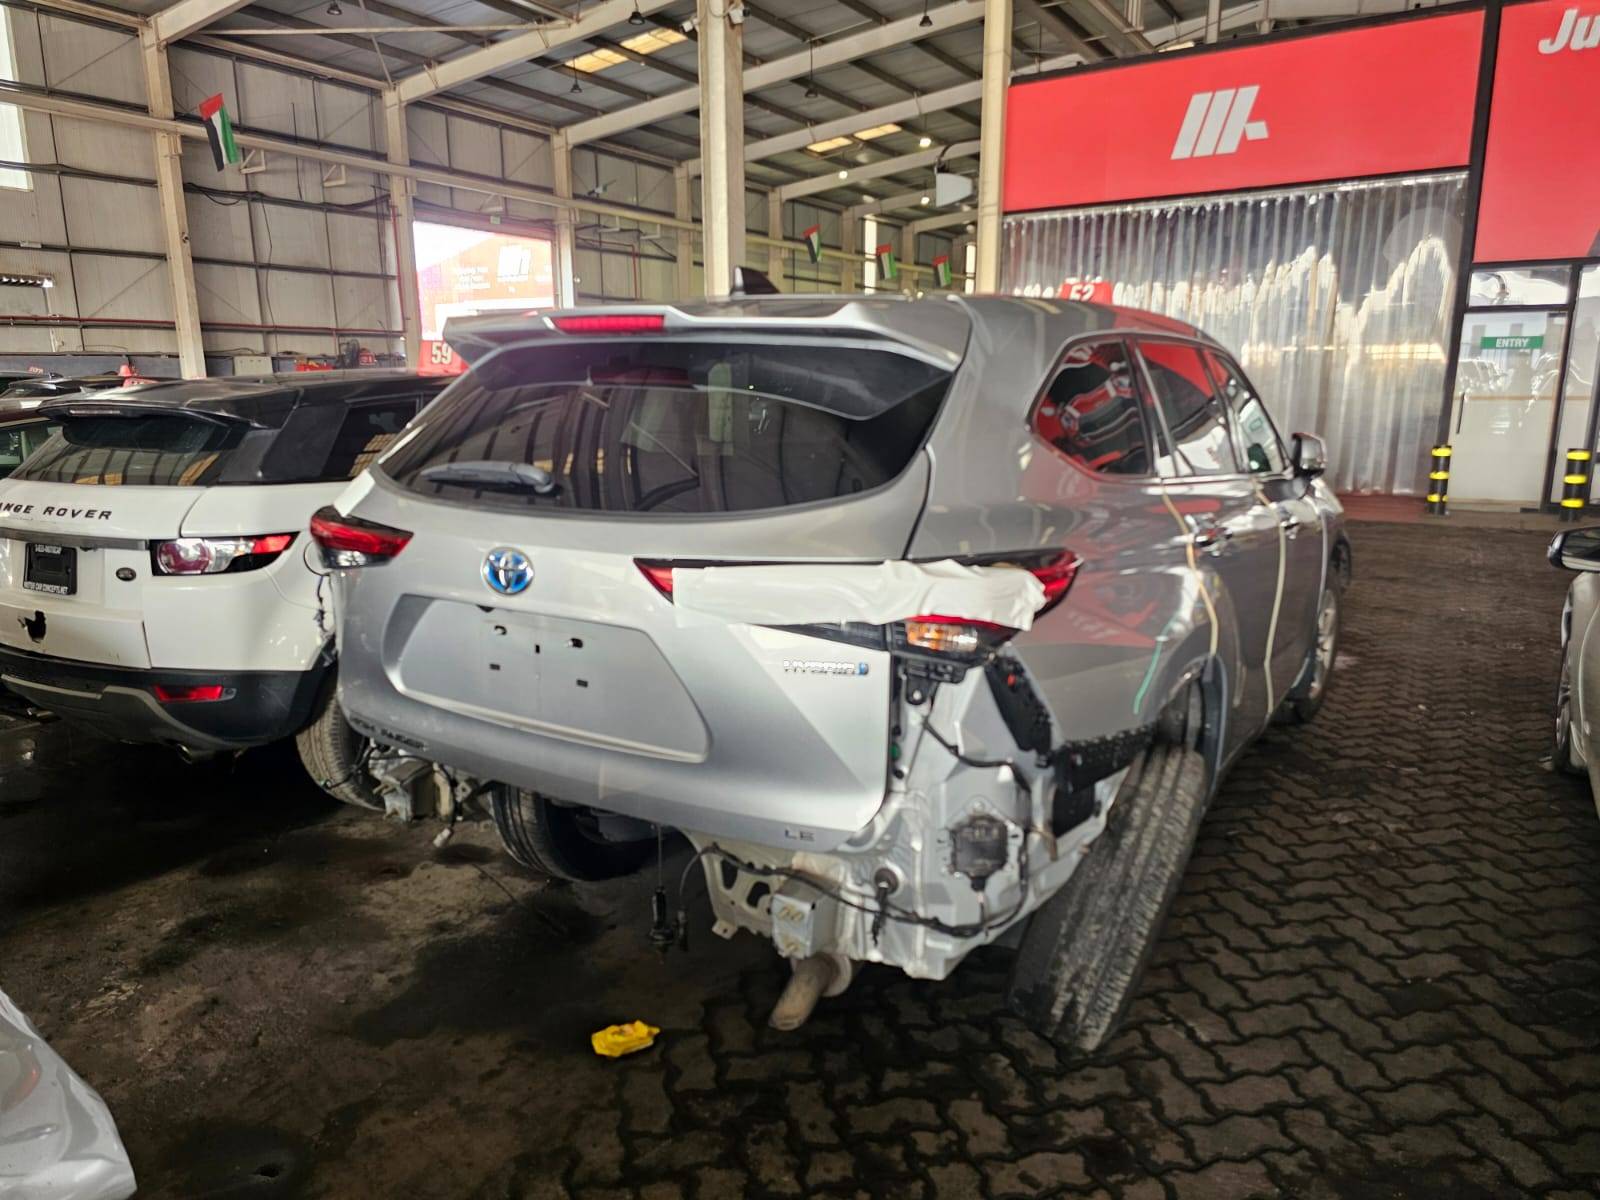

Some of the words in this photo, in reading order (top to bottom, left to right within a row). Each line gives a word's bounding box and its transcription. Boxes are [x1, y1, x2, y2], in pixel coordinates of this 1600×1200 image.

[1538, 9, 1600, 54] Ju
[1496, 338, 1529, 348] ENTRY
[431, 342, 451, 364] 59
[43, 506, 112, 520] ROVER
